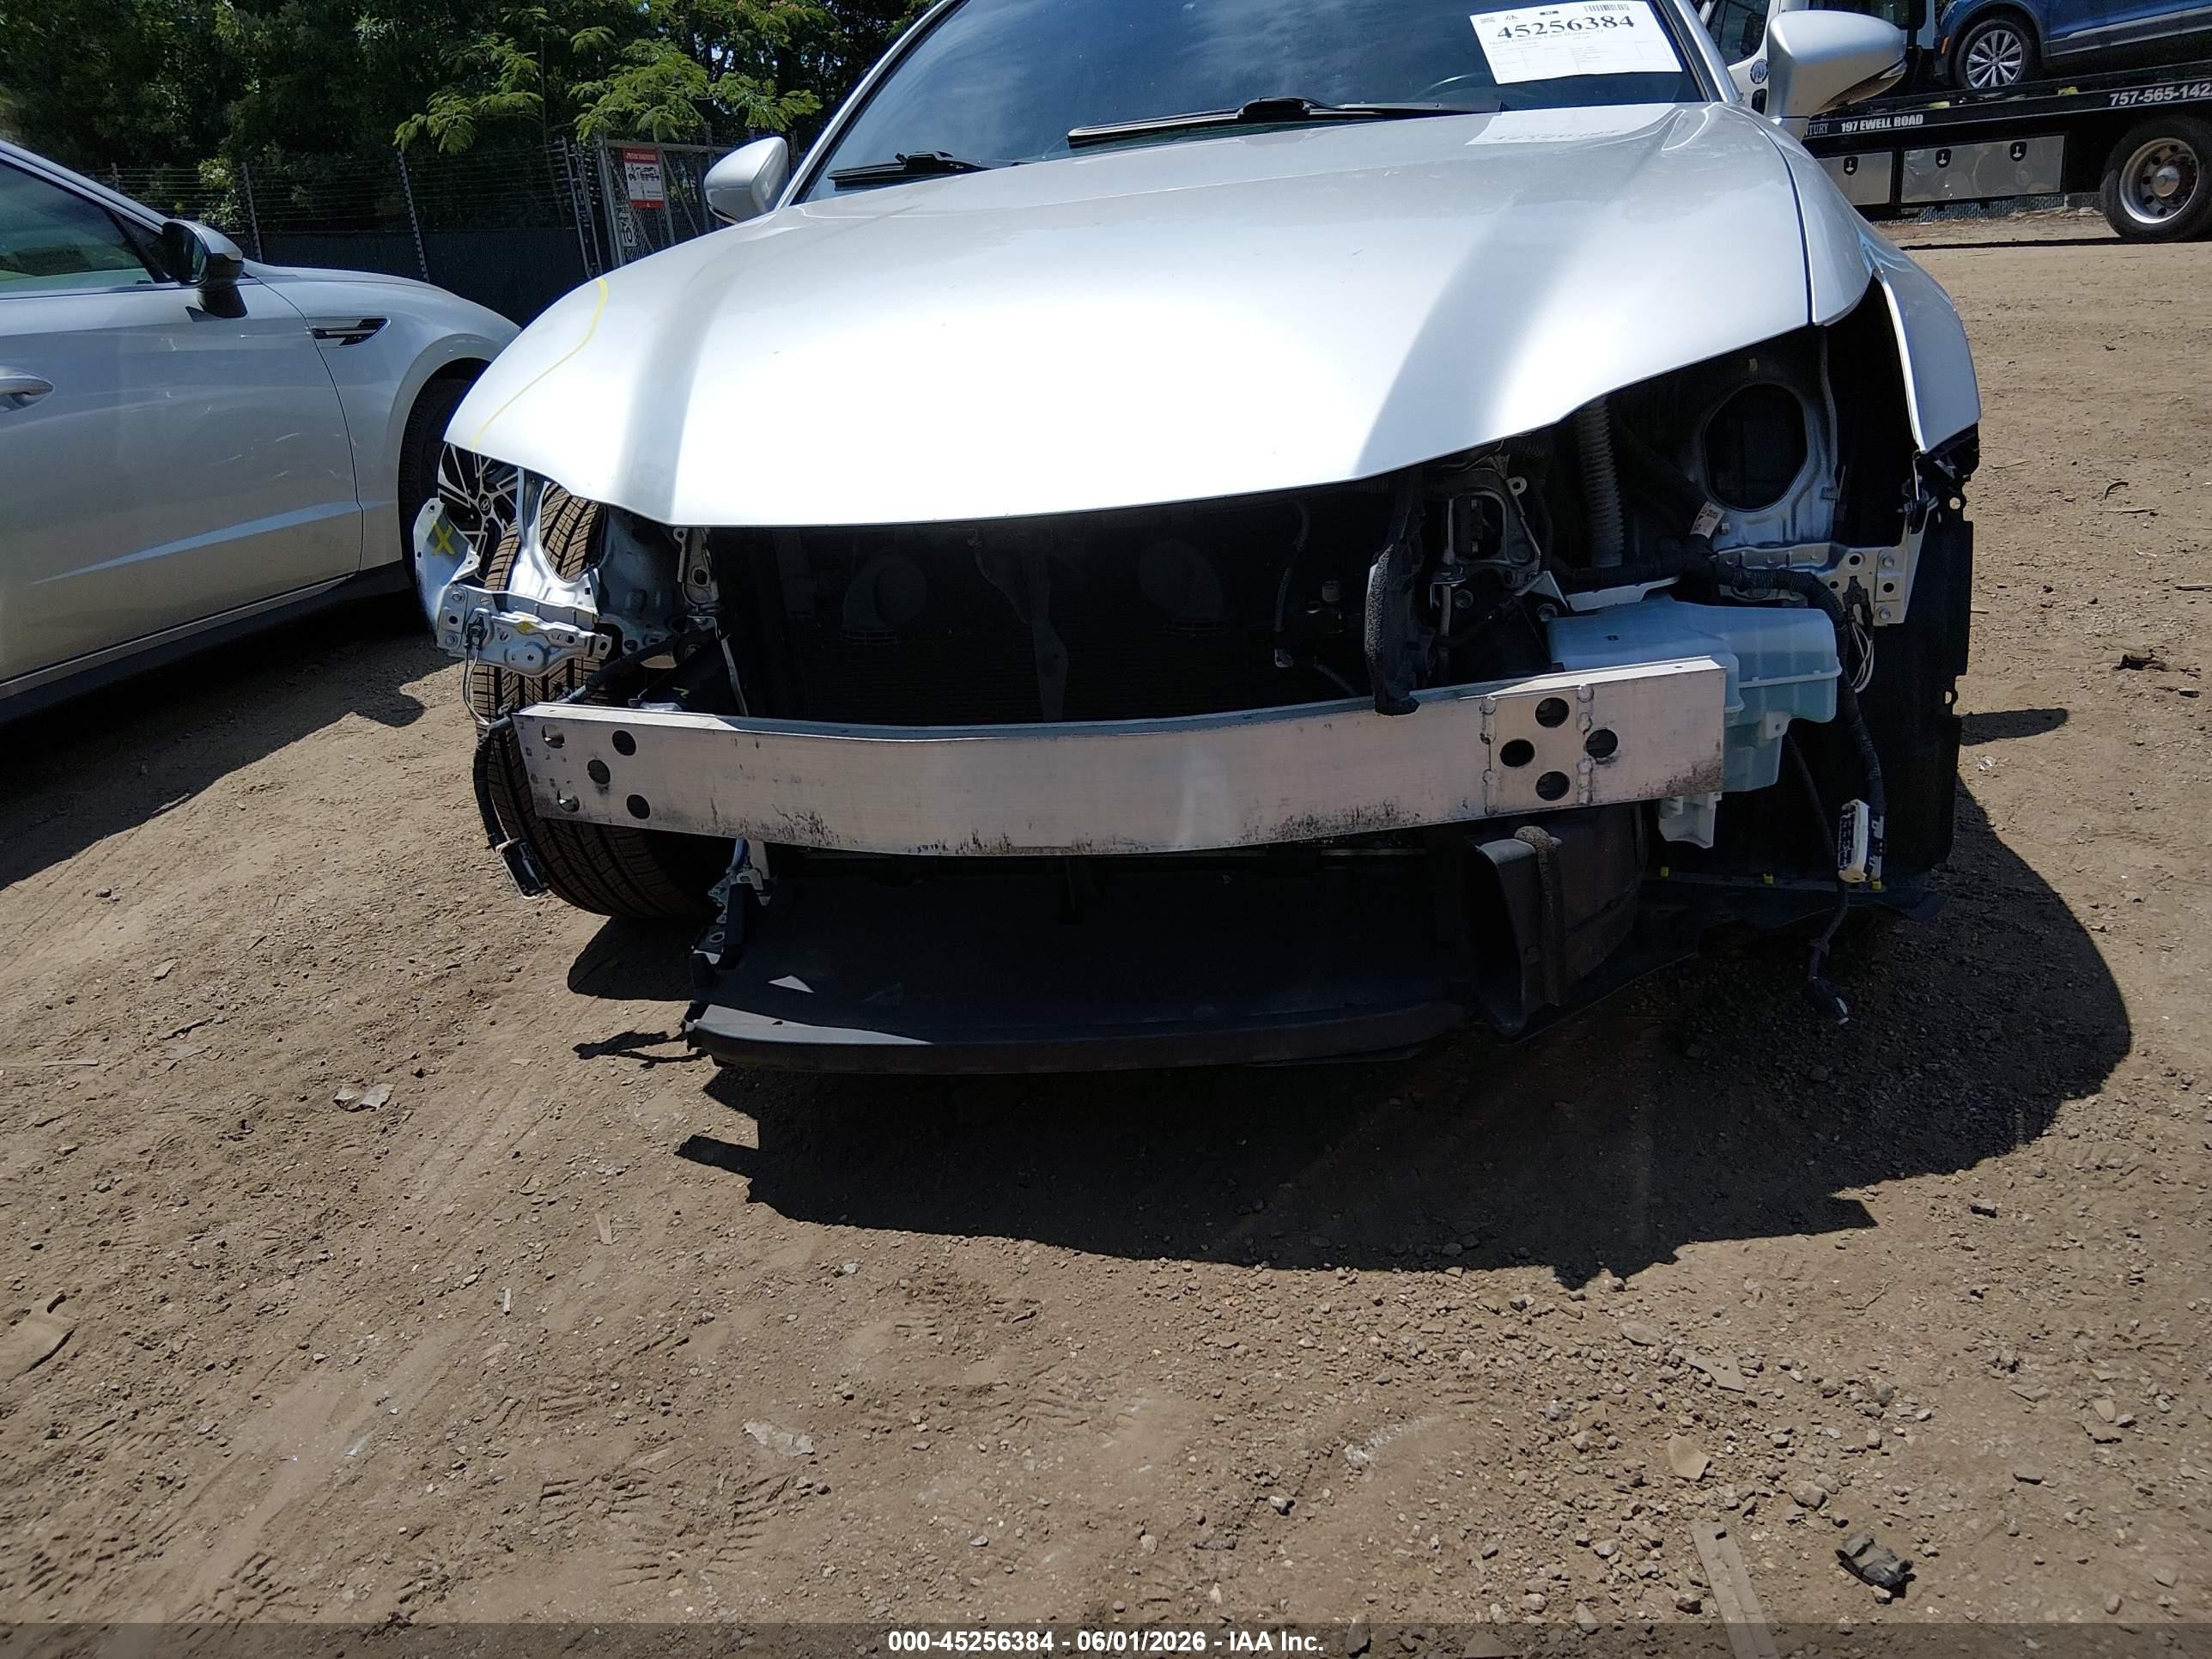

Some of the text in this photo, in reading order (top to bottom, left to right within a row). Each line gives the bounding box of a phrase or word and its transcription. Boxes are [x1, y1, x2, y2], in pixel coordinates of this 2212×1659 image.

[1497, 15, 1635, 39] 45256384
[2109, 82, 2212, 106] 757-565-142
[1805, 114, 1924, 136] TURY 197 EWELL ROAD
